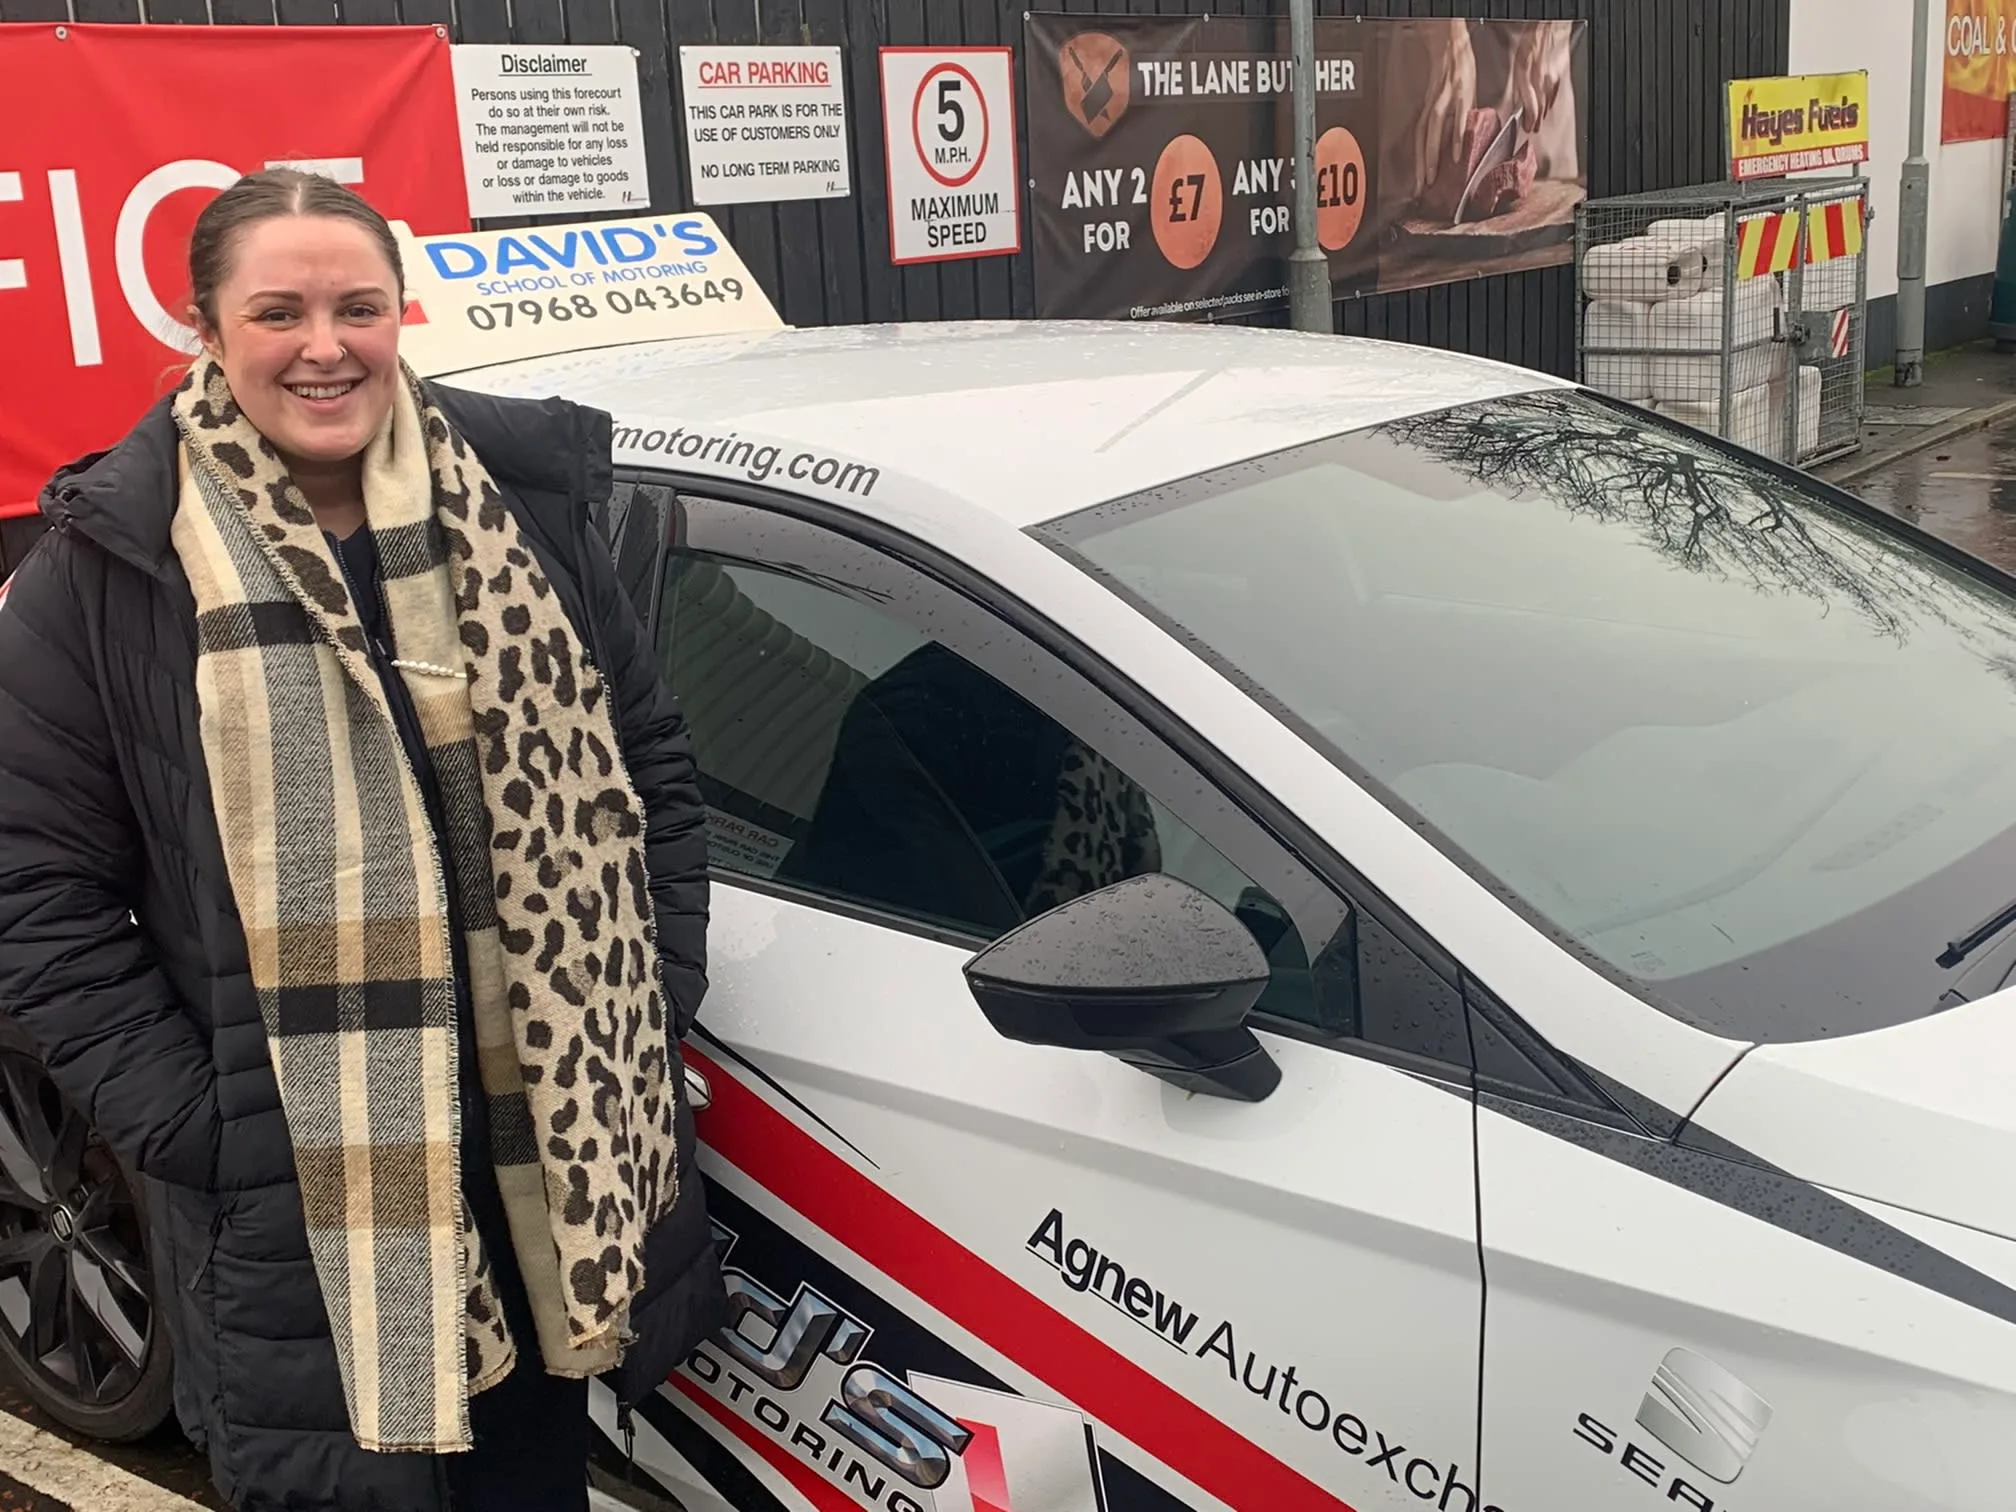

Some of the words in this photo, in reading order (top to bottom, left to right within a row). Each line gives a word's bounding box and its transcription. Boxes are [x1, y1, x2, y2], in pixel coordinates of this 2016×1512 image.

[1948, 15, 1991, 57] COAL
[1995, 15, 2007, 55] &
[501, 54, 587, 73] Disclaimer
[699, 61, 742, 84] CAR
[748, 61, 829, 84] PARKING
[1137, 61, 1183, 97] THE
[1190, 60, 1249, 95] LANE
[1257, 59, 1356, 94] BUHER
[471, 88, 516, 101] Persons
[520, 88, 549, 103] using
[552, 87, 571, 100] this
[574, 87, 622, 99] forecourt
[488, 106, 503, 118] do
[507, 108, 520, 118] so
[523, 106, 534, 117] at
[537, 105, 560, 117] their
[563, 106, 586, 116] own
[588, 104, 610, 116] risk.
[689, 105, 716, 120] THIS
[720, 104, 745, 119] CAR
[749, 104, 778, 118] PARK
[782, 104, 792, 117] IS
[796, 103, 818, 117] FOR
[821, 103, 842, 117] THE
[938, 80, 965, 142] 5
[476, 123, 497, 136] The
[500, 123, 569, 137] management
[572, 121, 589, 133] will
[592, 121, 608, 133] not
[611, 121, 624, 132] be
[694, 127, 718, 142] USE
[722, 127, 737, 141] OF
[741, 125, 810, 141] CUSTOMERS
[813, 125, 841, 138] ONLY
[1741, 103, 1804, 146] Hayes
[1808, 95, 1859, 133] Fuels
[475, 141, 499, 153] held
[502, 139, 565, 155] responsible
[568, 138, 582, 150] for
[585, 139, 603, 152] any
[606, 137, 628, 149] loss
[496, 158, 508, 170] or
[511, 156, 555, 171] damage
[557, 156, 568, 167] to
[571, 154, 613, 167] vehicles
[935, 147, 971, 164] M.P.H.
[1738, 153, 1789, 177] EMERGENCY
[1789, 149, 1822, 170] HEATING
[1822, 147, 1835, 165] OIL
[1835, 143, 1864, 162] DRUMS
[482, 177, 494, 188] or
[497, 175, 521, 187] loss
[523, 175, 535, 186] or
[538, 173, 580, 187] damage
[583, 172, 594, 183] to
[597, 170, 629, 185] goods
[701, 164, 719, 178] NO
[722, 163, 755, 177] LONG
[758, 161, 790, 176] TERM
[793, 159, 840, 175] PARKING
[1232, 158, 1284, 196] ANY
[1317, 162, 1358, 208] £10
[512, 191, 544, 203] within
[547, 190, 564, 202] the
[567, 187, 605, 201] vehicle.
[1061, 168, 1123, 209] ANY
[1131, 167, 1147, 205] 2
[1169, 173, 1206, 222] £7
[911, 192, 999, 221] MAXIMUM
[1250, 206, 1290, 236] FOR
[424, 219, 720, 280] DAVID'S
[927, 222, 987, 248] SPEED
[1083, 221, 1130, 253] FOR
[476, 274, 568, 297] SCHOOL
[570, 270, 596, 287] OF
[602, 260, 708, 283] MOTORING
[466, 294, 599, 331] 07968
[605, 276, 744, 315] 043649
[1130, 305, 1151, 319] Offer
[1151, 301, 1183, 316] available
[1184, 300, 1195, 312] on
[1195, 295, 1224, 310] selected
[1243, 293, 1255, 303] see
[1256, 289, 1281, 300] in-store
[1281, 285, 1290, 297] fo
[612, 420, 880, 496] motoring.com
[1026, 1208, 1199, 1345] Agnew
[686, 1348, 925, 1512] OTORING
[1195, 1320, 1503, 1512] Autoexch
[1573, 1411, 1728, 1512] SEA
